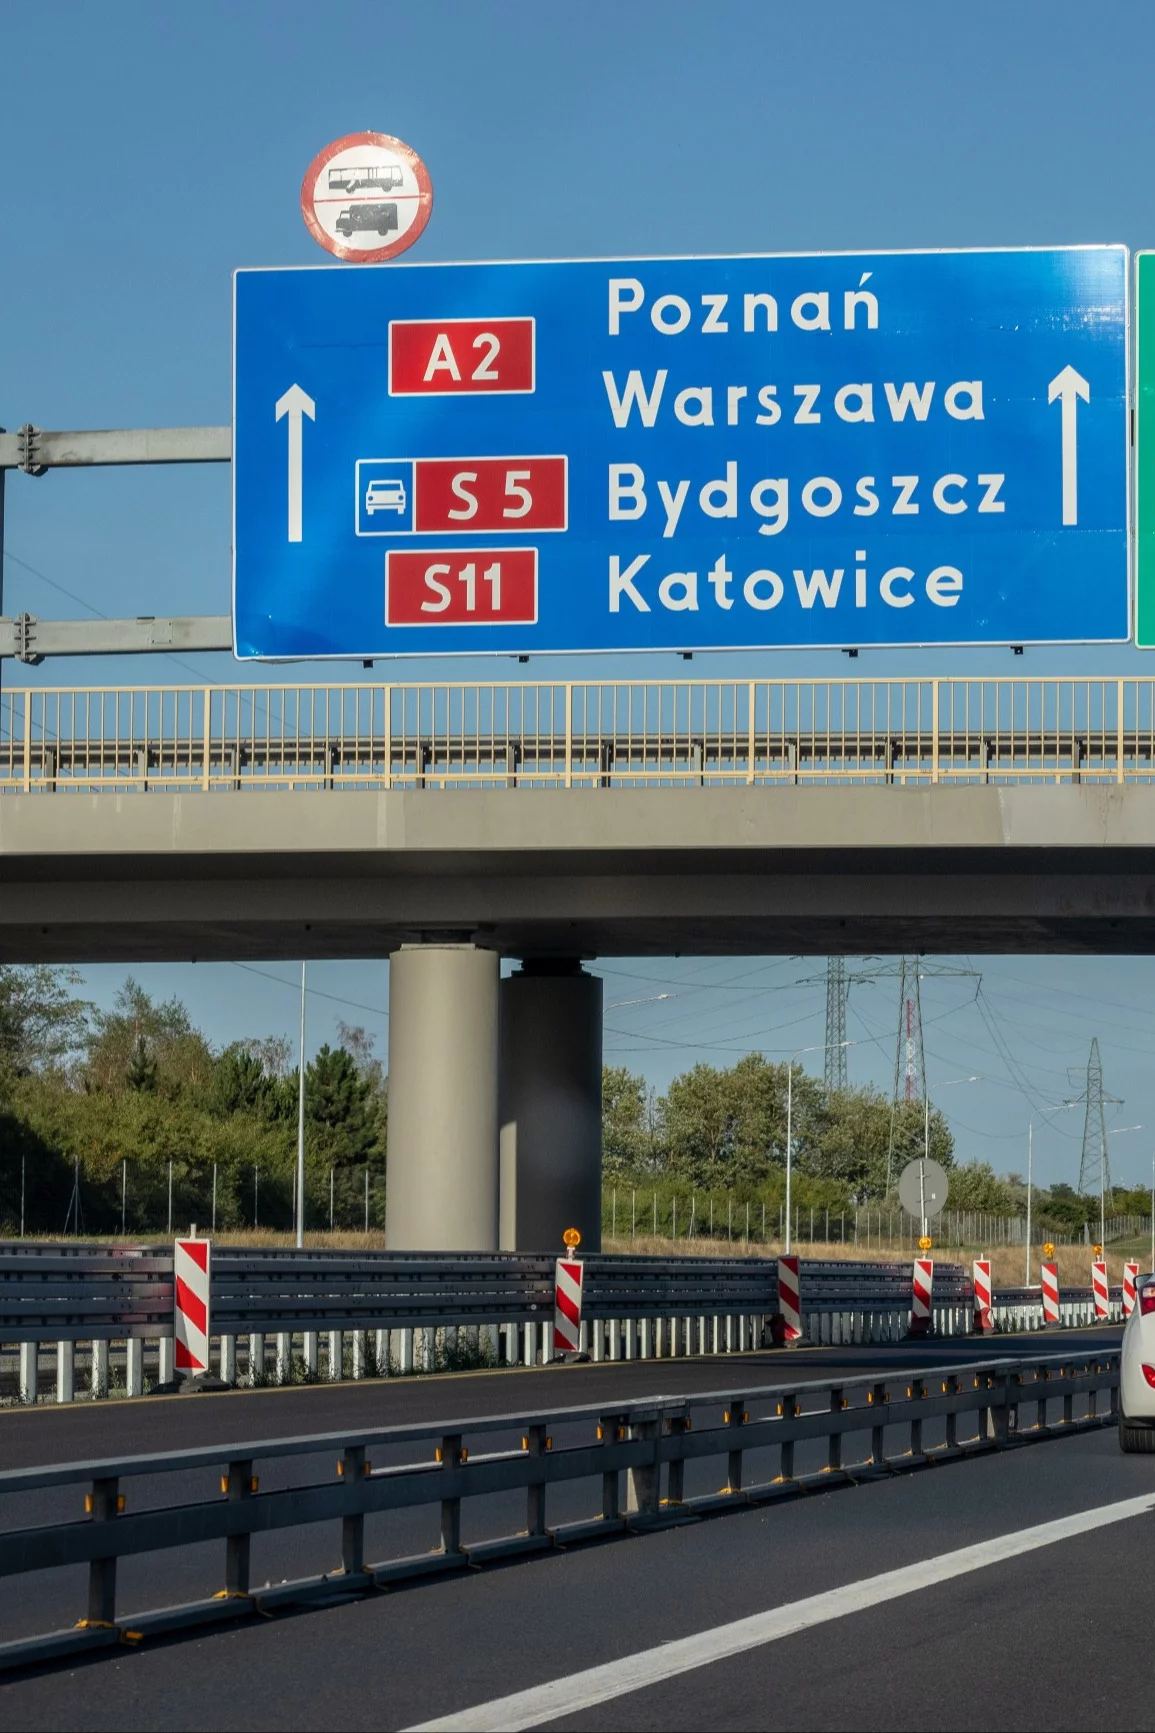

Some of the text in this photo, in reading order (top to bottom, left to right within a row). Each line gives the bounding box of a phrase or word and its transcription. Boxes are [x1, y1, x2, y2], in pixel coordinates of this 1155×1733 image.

[607, 271, 880, 337] Poznań
[423, 331, 501, 382] A2
[602, 369, 986, 429] Warszawa
[607, 461, 1007, 539] Bydgoszcz
[420, 561, 503, 613] S11
[608, 549, 965, 614] Katowice
